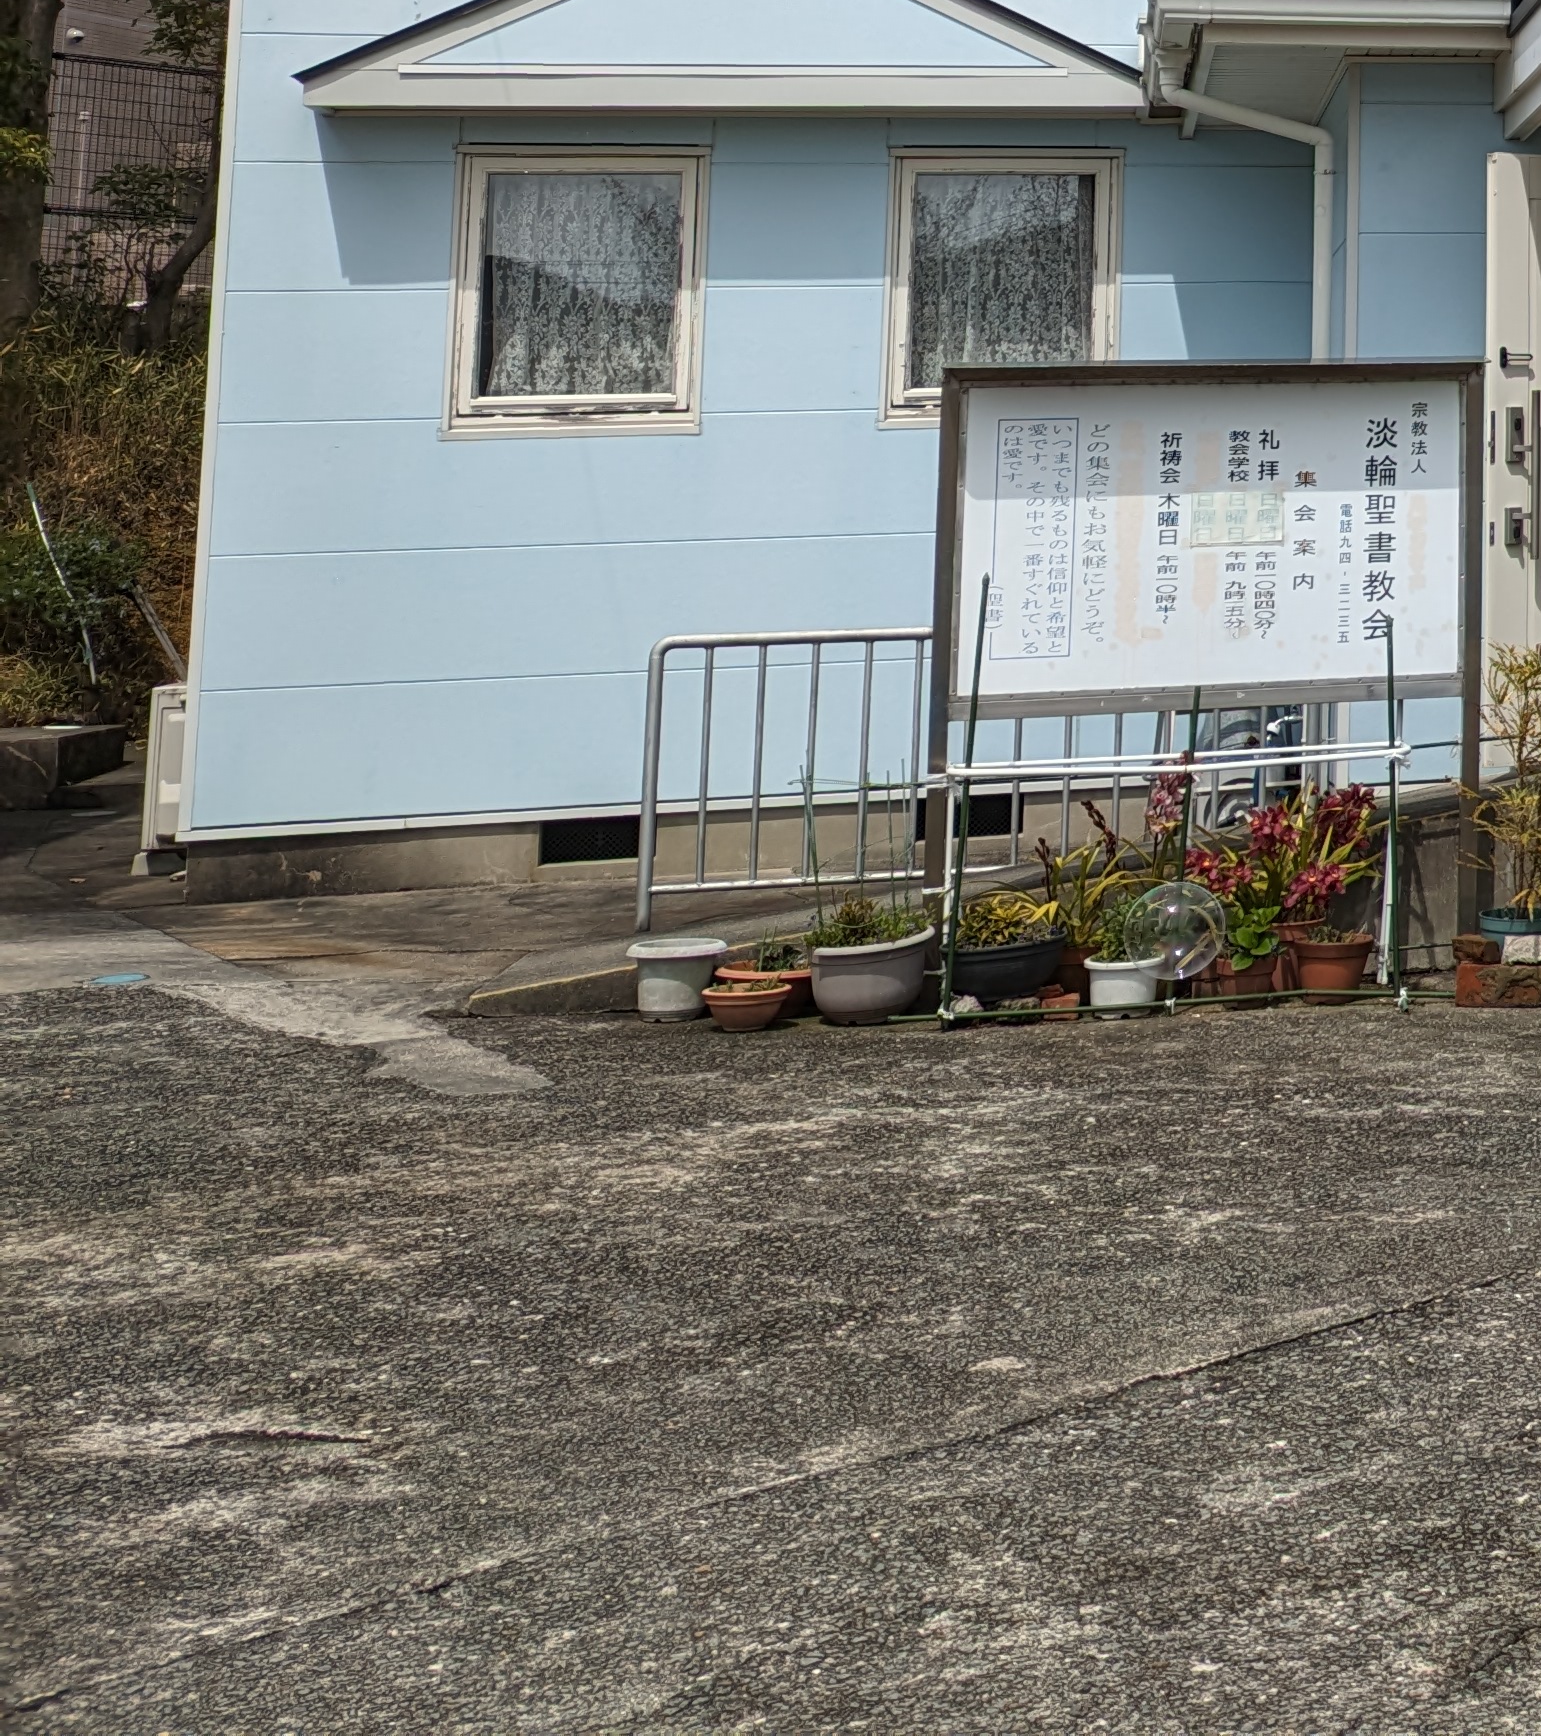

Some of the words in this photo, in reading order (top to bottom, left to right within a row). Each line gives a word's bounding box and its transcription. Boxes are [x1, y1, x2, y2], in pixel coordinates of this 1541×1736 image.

[1001, 424, 1024, 489] のは愛です。
[1159, 431, 1183, 484] 祈祷会
[1227, 430, 1251, 482] 教会学校
[1258, 429, 1280, 481] 礼拝
[1411, 402, 1429, 474] 宗教法人
[1020, 424, 1048, 655] 愛です。その中で一番すぐれている
[1045, 425, 1073, 653] いつまでも残るものは信仰と希望と
[1081, 424, 1111, 644] どの集会にもお気軽にどうぞ。
[1157, 493, 1181, 546] 木曜日
[1292, 470, 1317, 591] 集会案内
[1362, 417, 1398, 641] 淡輪聖書教会
